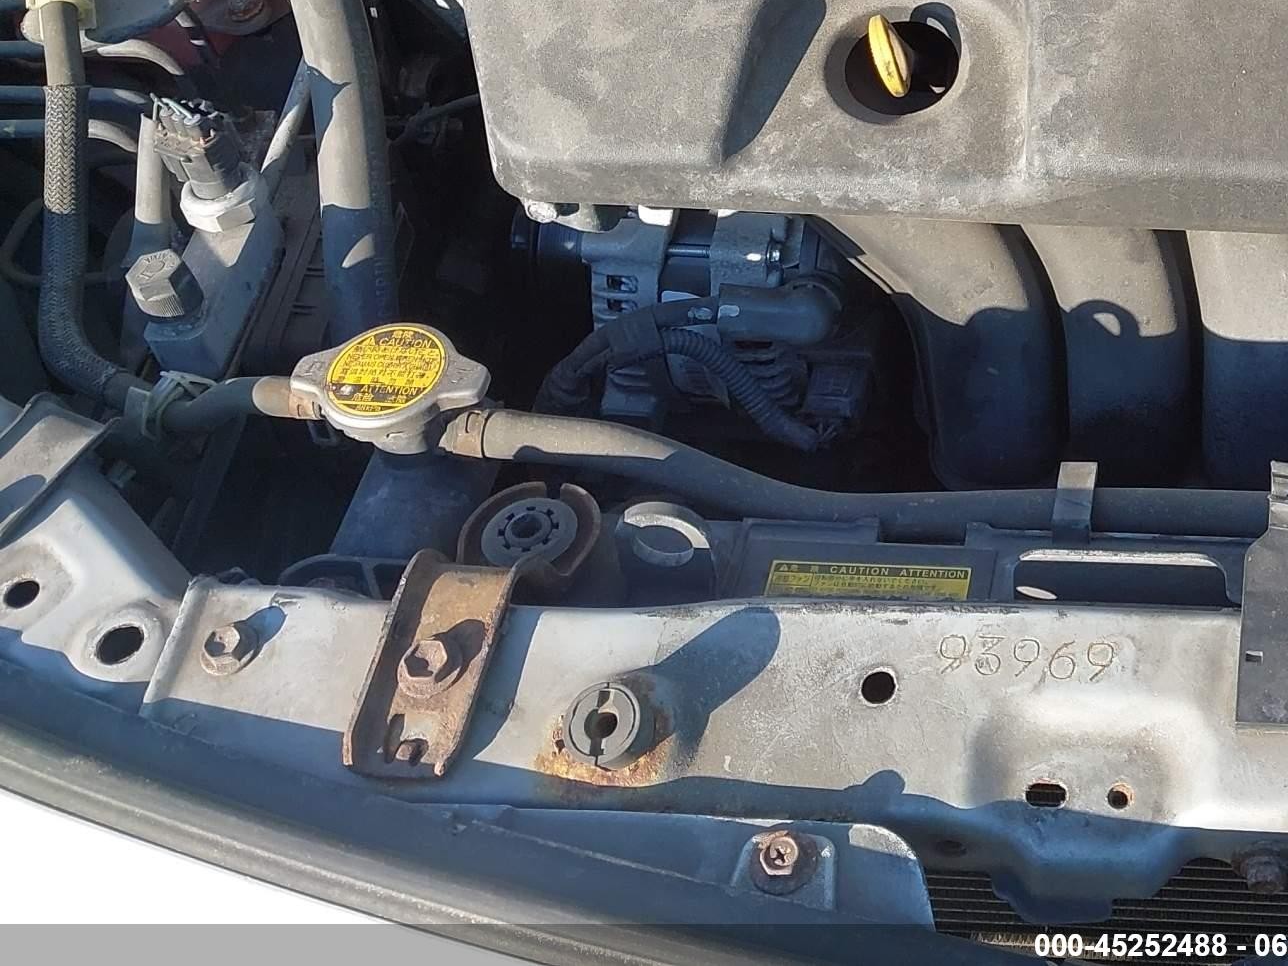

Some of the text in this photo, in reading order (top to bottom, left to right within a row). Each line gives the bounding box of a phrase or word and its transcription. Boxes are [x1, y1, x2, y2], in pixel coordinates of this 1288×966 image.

[379, 337, 432, 348] CAUTION
[360, 384, 418, 395] ATTENTION
[829, 566, 966, 579] CAUTION ATTENTION
